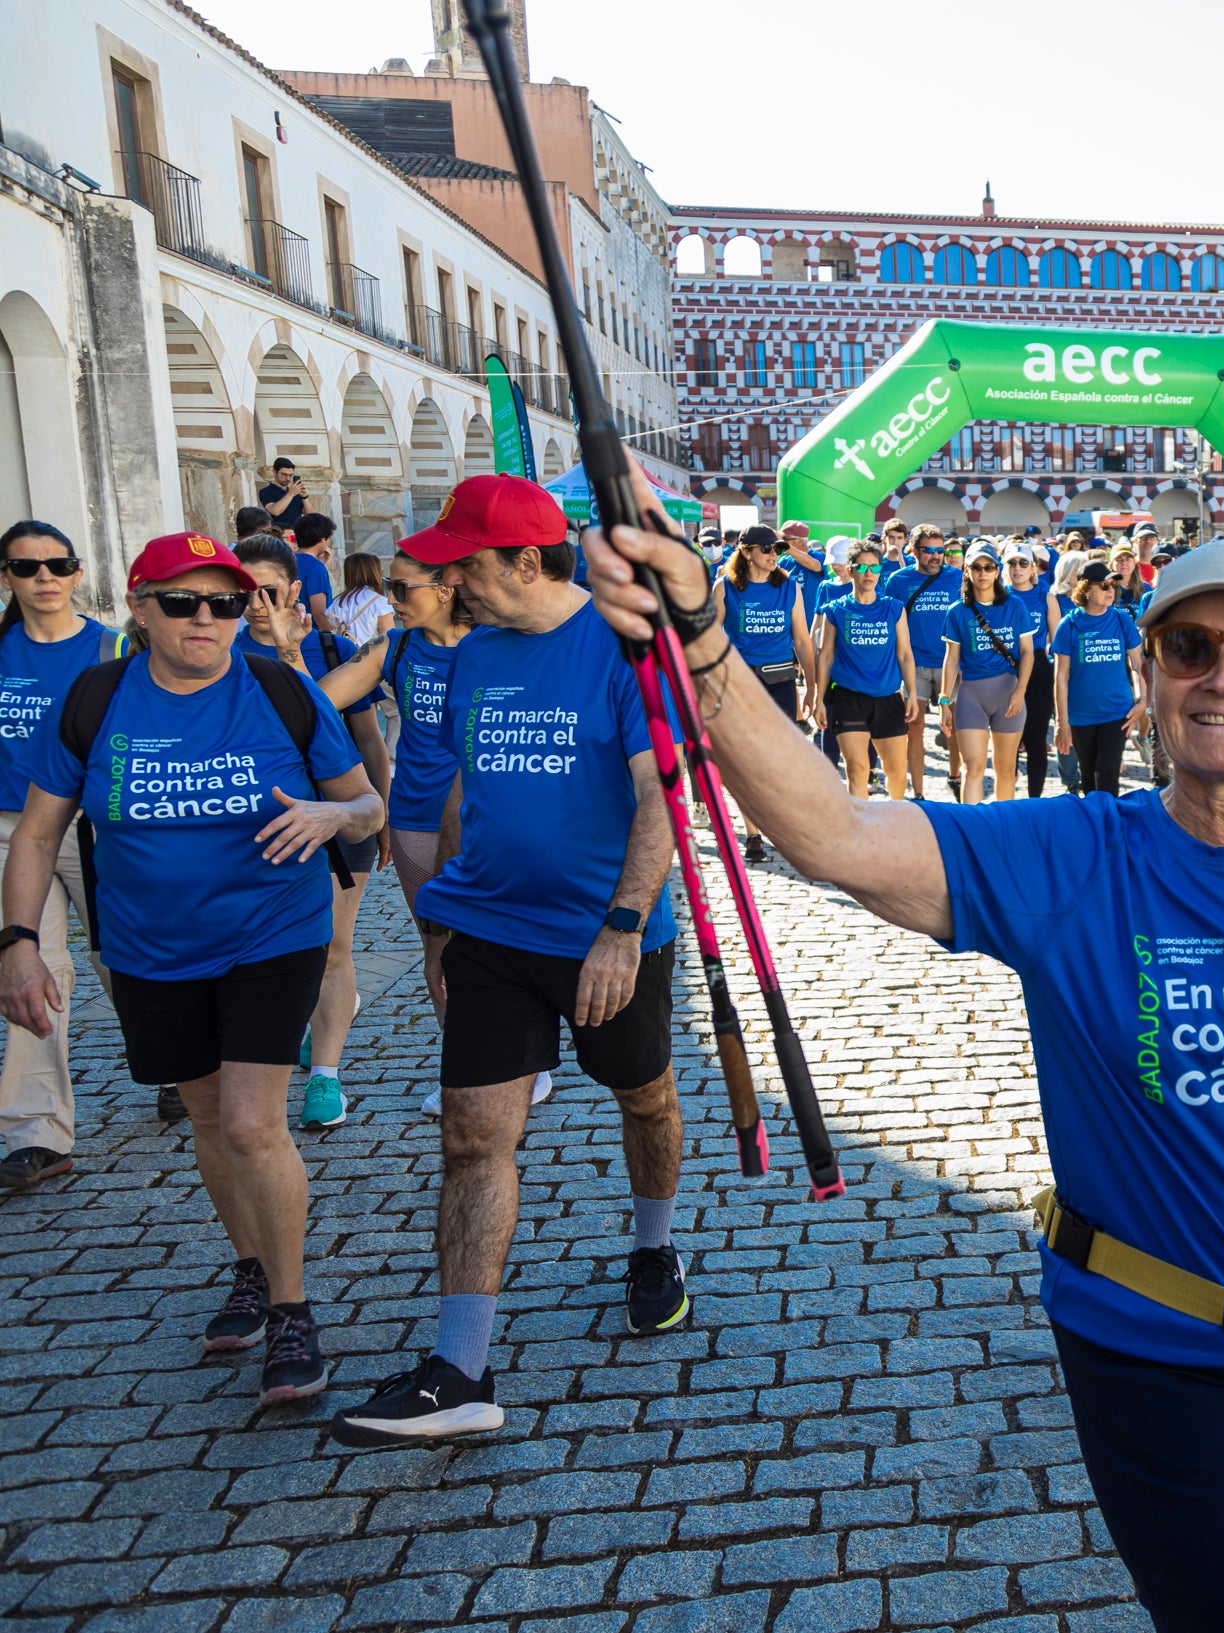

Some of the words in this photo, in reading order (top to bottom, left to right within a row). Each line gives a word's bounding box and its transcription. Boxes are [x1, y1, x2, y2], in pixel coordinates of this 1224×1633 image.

[1023, 343, 1163, 386] aecc
[985, 387, 1048, 401] Asociación
[1050, 390, 1101, 403] Española
[1104, 394, 1139, 404] contra
[1142, 393, 1152, 404] el
[1154, 393, 1194, 405] Cáncer
[870, 376, 951, 458] aecc
[745, 616, 776, 624] contra
[777, 615, 785, 623] el
[756, 609, 785, 617] marcha
[745, 624, 786, 633] cáncer
[993, 626, 1013, 634] archa
[851, 635, 889, 645] cáncer
[1085, 645, 1113, 653] contra
[1085, 653, 1122, 663] cáncer
[415, 677, 430, 690] En
[0, 691, 22, 704] En
[0, 706, 46, 720] cont
[480, 706, 504, 723] En
[508, 706, 578, 724] marcha
[478, 726, 547, 744] contra
[553, 726, 576, 746] el
[131, 758, 161, 774] En
[167, 753, 256, 774] marcha
[476, 747, 577, 775] cáncer
[108, 755, 126, 821] BADAJOZ
[129, 775, 224, 794] contra
[231, 768, 259, 786] el
[129, 793, 263, 821] cáncer
[1164, 978, 1213, 1010] En
[1137, 972, 1164, 1104] BADAJOZ
